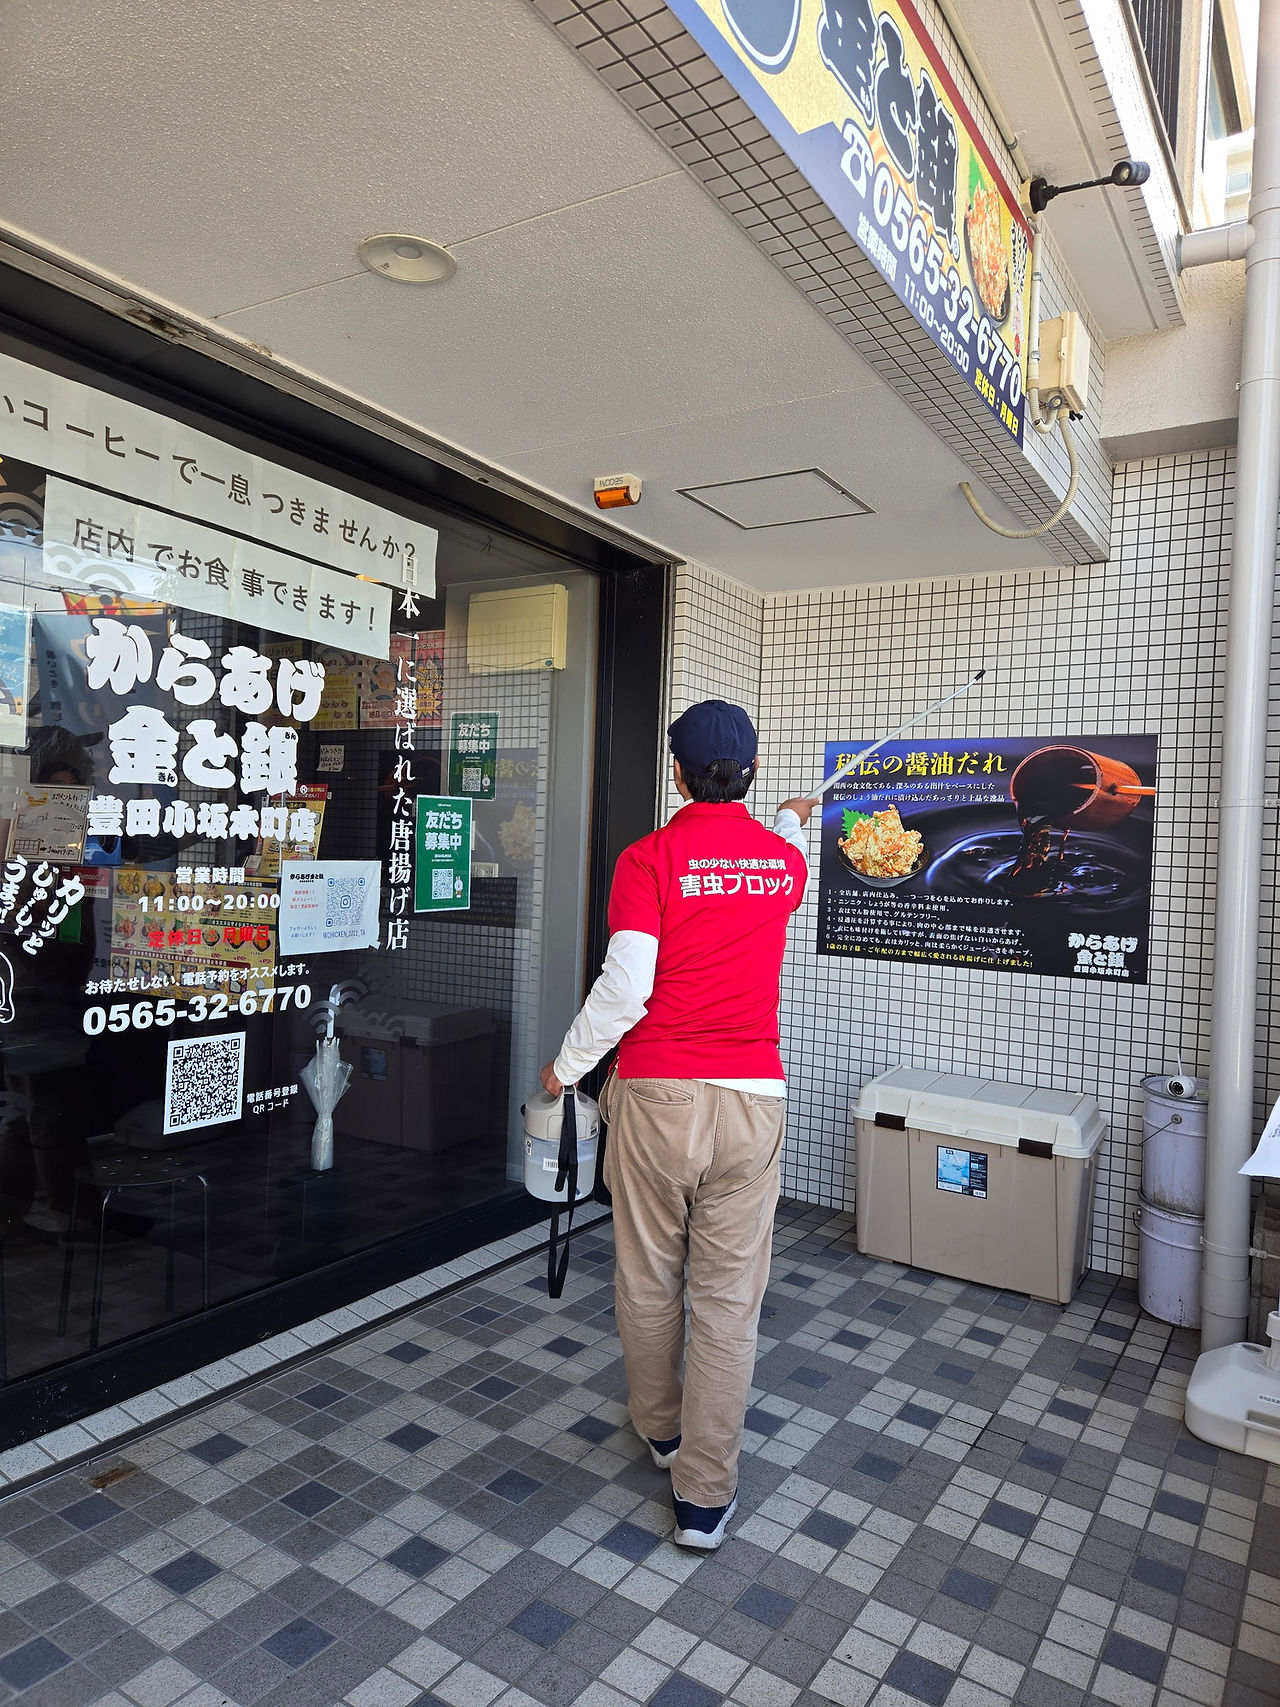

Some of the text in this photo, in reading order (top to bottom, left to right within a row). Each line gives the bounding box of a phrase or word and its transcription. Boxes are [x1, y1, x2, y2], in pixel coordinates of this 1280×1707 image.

[857, 212, 898, 283] 営業時間
[872, 166, 1021, 408] 0565-32-6770
[73, 517, 376, 631] 店内でお食事できます!
[86, 618, 325, 721] からあげ
[458, 722, 491, 738] 友だち
[108, 705, 299, 795] 金と銀
[384, 551, 422, 951] 日本一に選ばれた唐揚げ店
[457, 739, 490, 754] 募集中
[87, 795, 318, 842] 豊田小坂本町店
[425, 810, 463, 830] 友だち
[424, 832, 462, 851] 募集中
[175, 866, 246, 885] 営業時間
[688, 858, 786, 870] 虫の少ない快適な環境
[679, 871, 794, 898] 害虫ブロック
[22, 875, 85, 955] カリッと
[1068, 932, 1138, 953] からあげ
[1076, 949, 1125, 968] 金と銀
[85, 963, 310, 995] お待たせしない、電話予約をオススメします。
[83, 985, 311, 1036] 0565-32-6770
[246, 1084, 298, 1103] 電話番号登録
